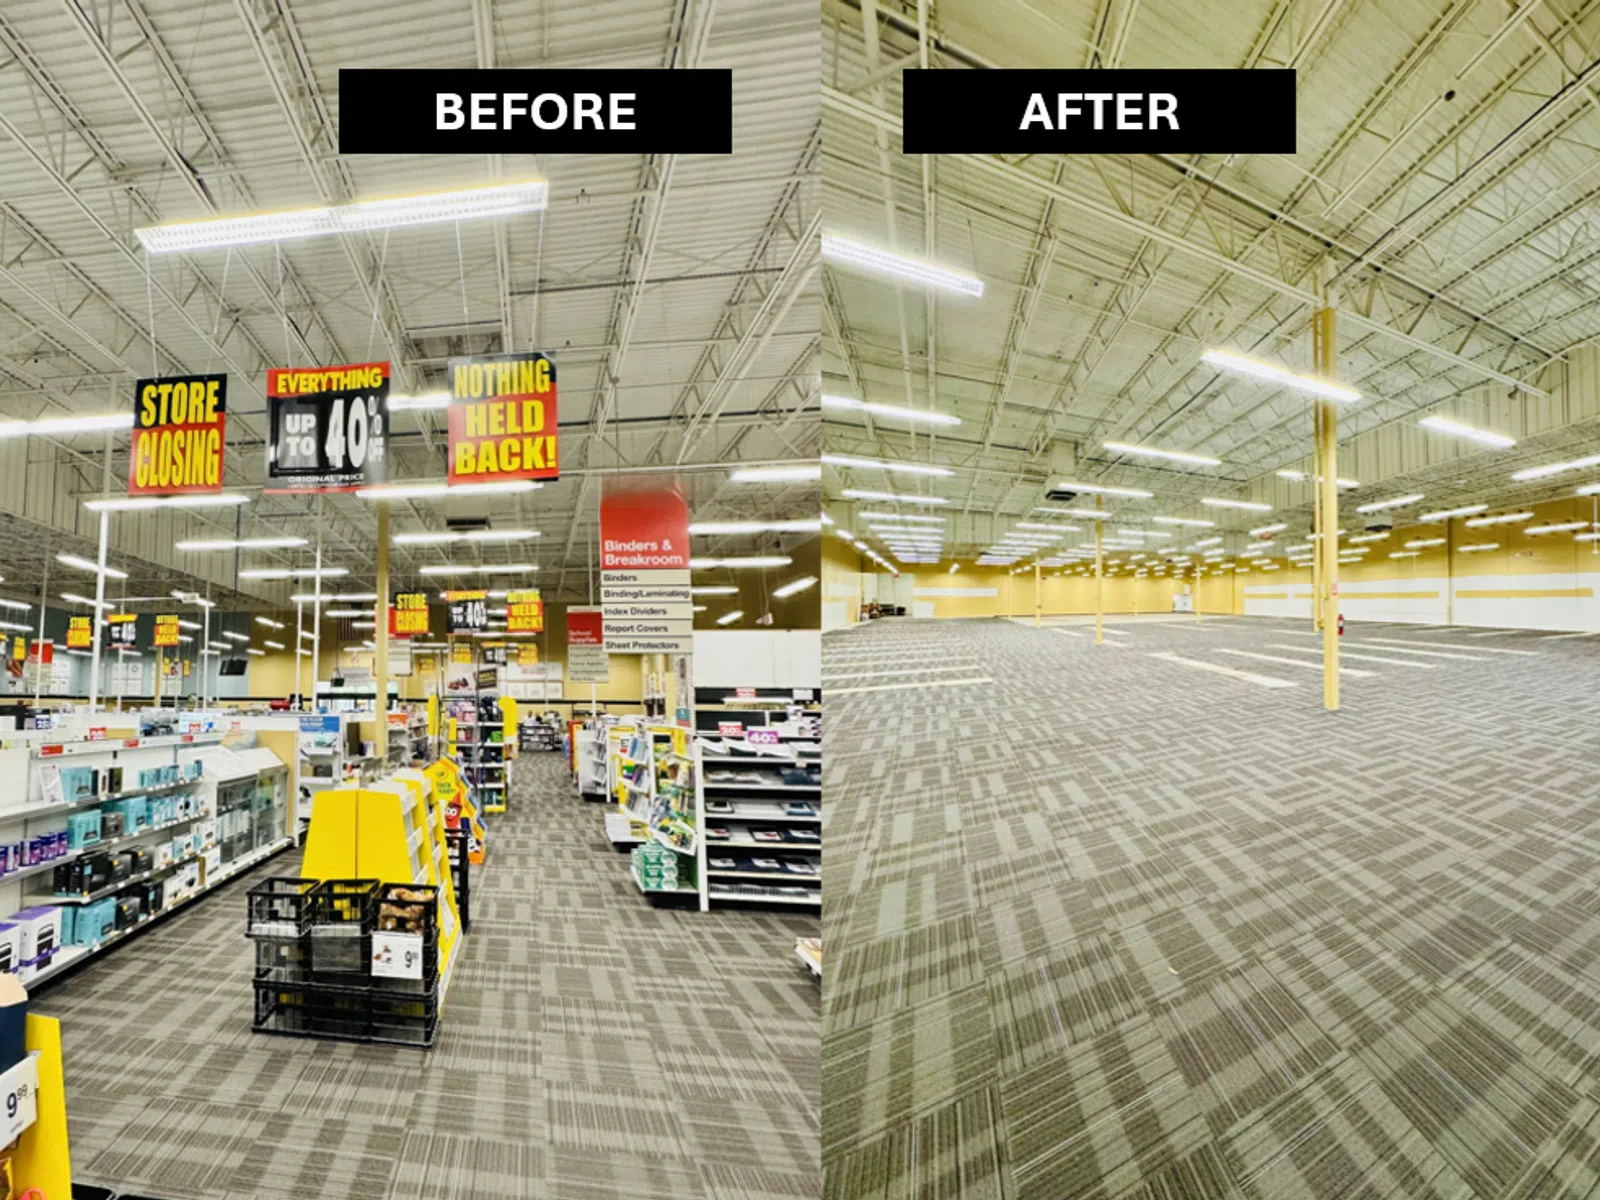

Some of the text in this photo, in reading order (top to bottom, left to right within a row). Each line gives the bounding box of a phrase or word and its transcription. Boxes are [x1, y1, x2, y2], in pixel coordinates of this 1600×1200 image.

[277, 366, 383, 394] EVERYTHING
[454, 358, 551, 399] NOTHING
[141, 381, 220, 427] STORE
[285, 413, 317, 434] UP
[465, 399, 545, 438] HELD
[285, 436, 317, 457] TO
[455, 435, 557, 475] BACK!
[136, 428, 221, 488] CLOSING
[288, 474, 335, 484] ORIGINAL
[604, 538, 673, 552] Binders &
[604, 553, 684, 566] Breakroom
[603, 573, 638, 582] Binders
[396, 593, 427, 610] STORE
[603, 589, 690, 599] Binding/Laminating
[604, 606, 668, 616] Index Dividers
[604, 624, 669, 634] Report Covers
[605, 640, 631, 650] Sheet
[631, 641, 680, 650] Protectors
